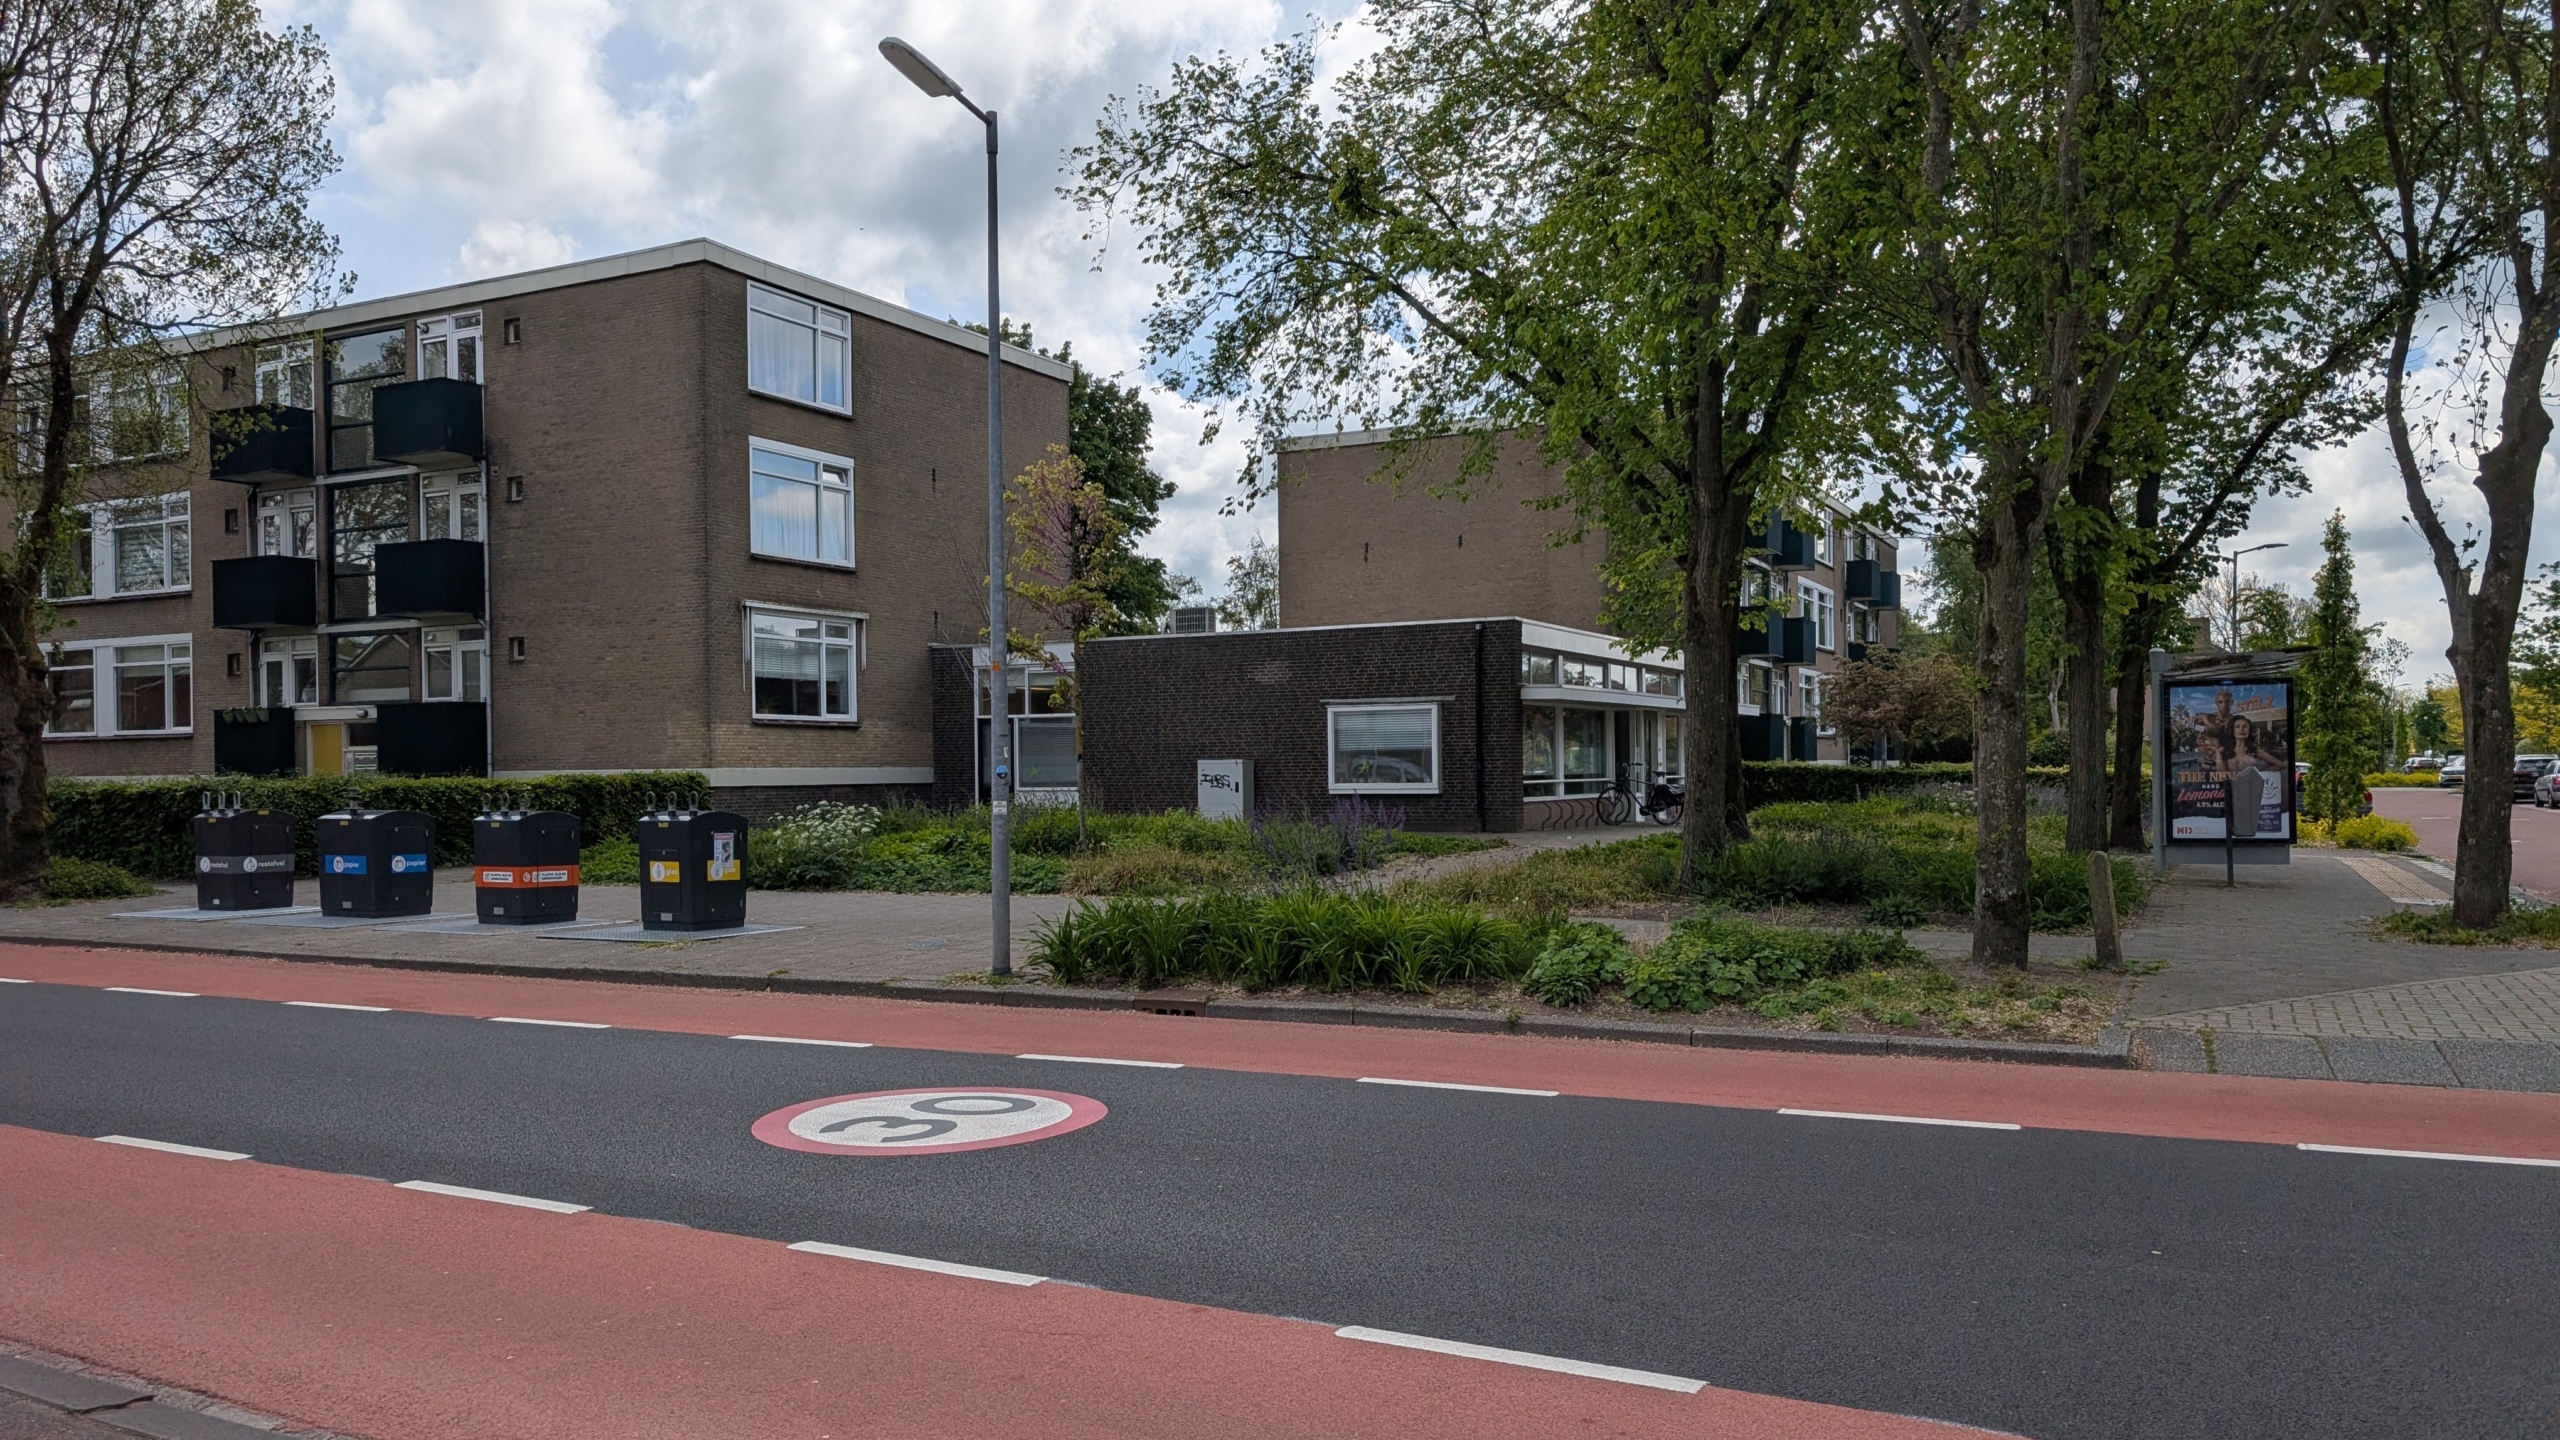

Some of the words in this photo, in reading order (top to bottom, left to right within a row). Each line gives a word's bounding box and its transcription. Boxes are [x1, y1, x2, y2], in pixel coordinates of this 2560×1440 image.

[2178, 771, 2206, 783] THE
[2177, 788, 2225, 802] Lemona
[258, 859, 285, 868] restafval
[344, 860, 359, 869] papier
[406, 859, 426, 868] papier
[665, 868, 678, 877] glas
[818, 1095, 1037, 1143] 30
